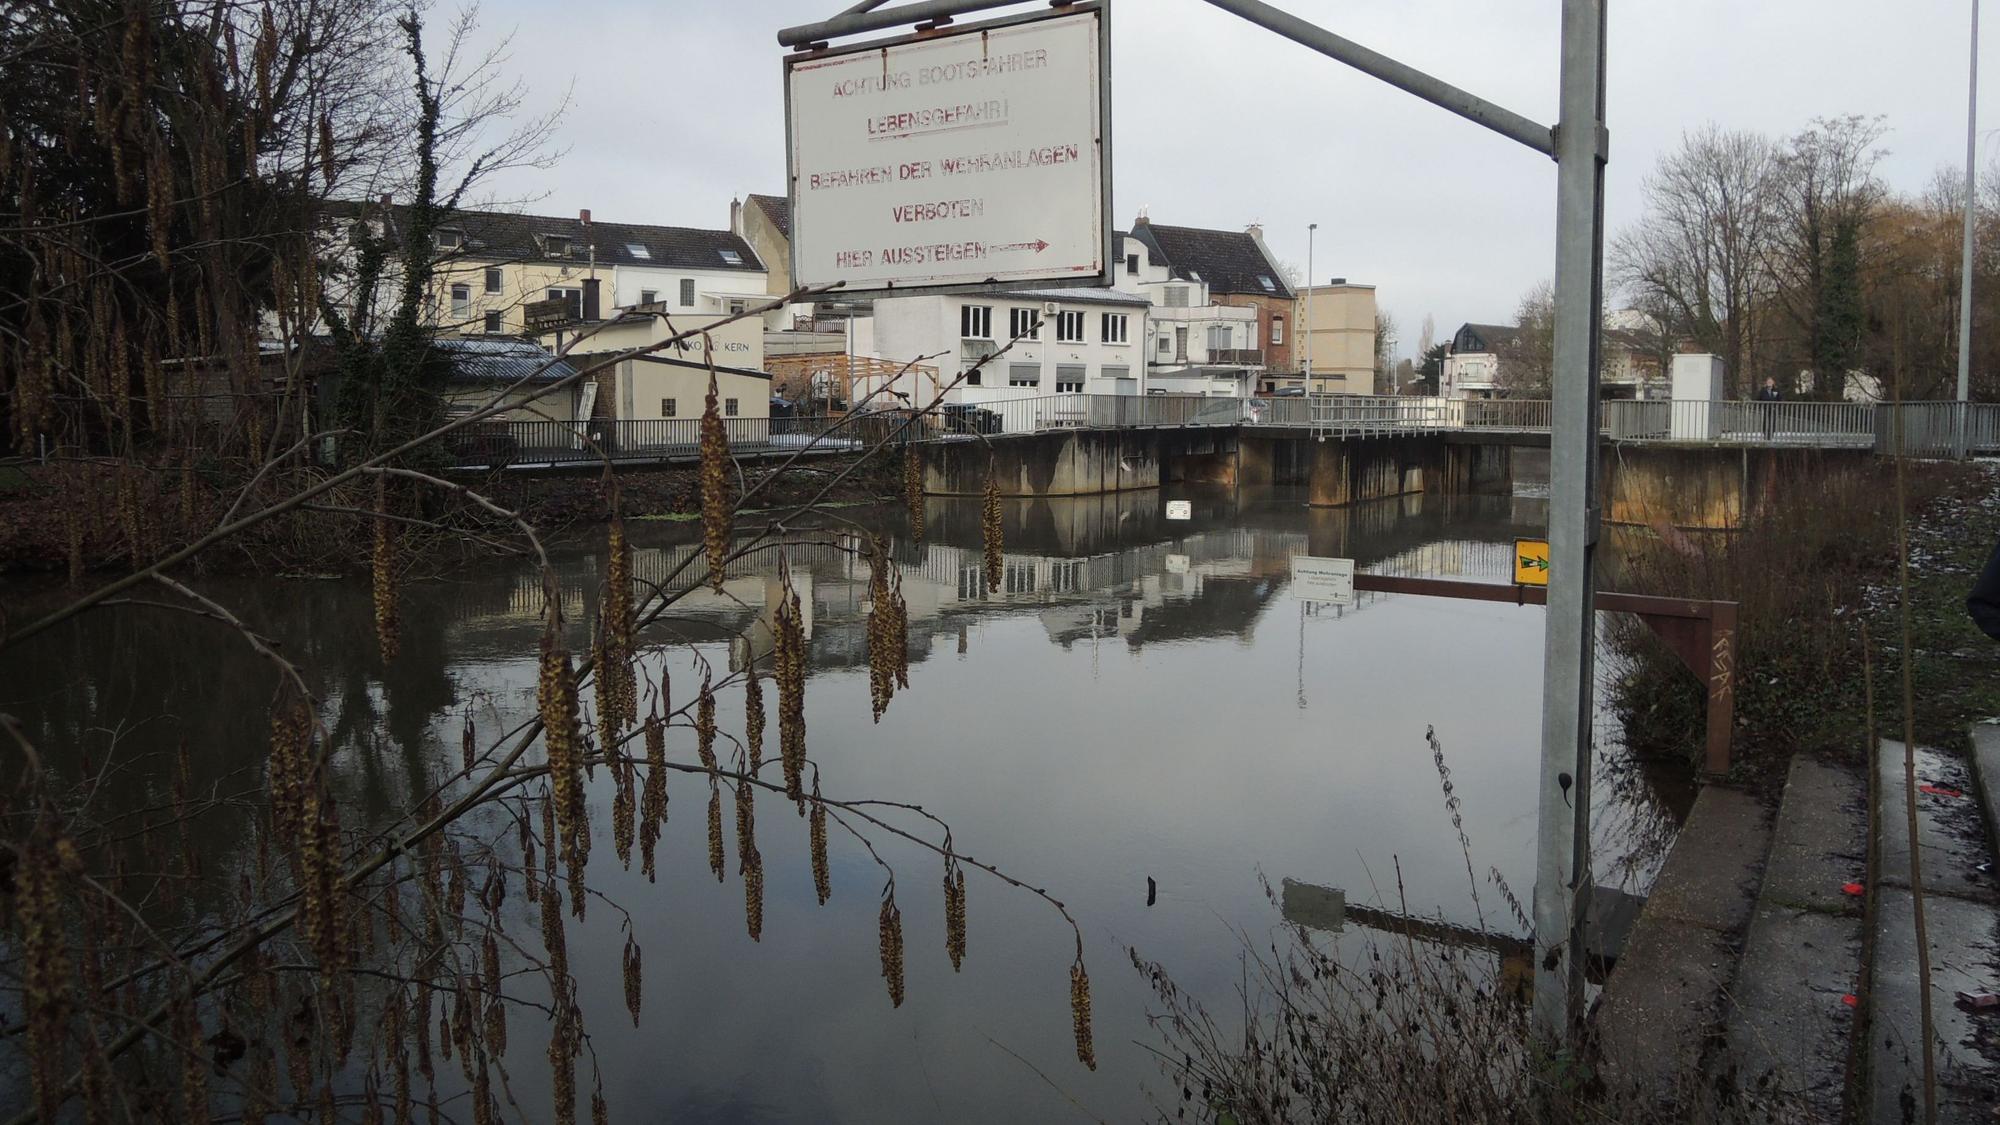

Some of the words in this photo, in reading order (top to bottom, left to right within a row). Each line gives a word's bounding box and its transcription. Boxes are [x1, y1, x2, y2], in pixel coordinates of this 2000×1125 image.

[832, 72, 912, 99] ACHTUNG
[810, 165, 893, 191] BEFAHREN
[900, 161, 932, 181] DER
[940, 144, 1079, 177] WEHRANLAGEN
[893, 198, 984, 223] VERBOTEN
[836, 250, 873, 269] HIER
[880, 241, 988, 266] AUSSTEIGEN
[724, 342, 750, 352] KERN
